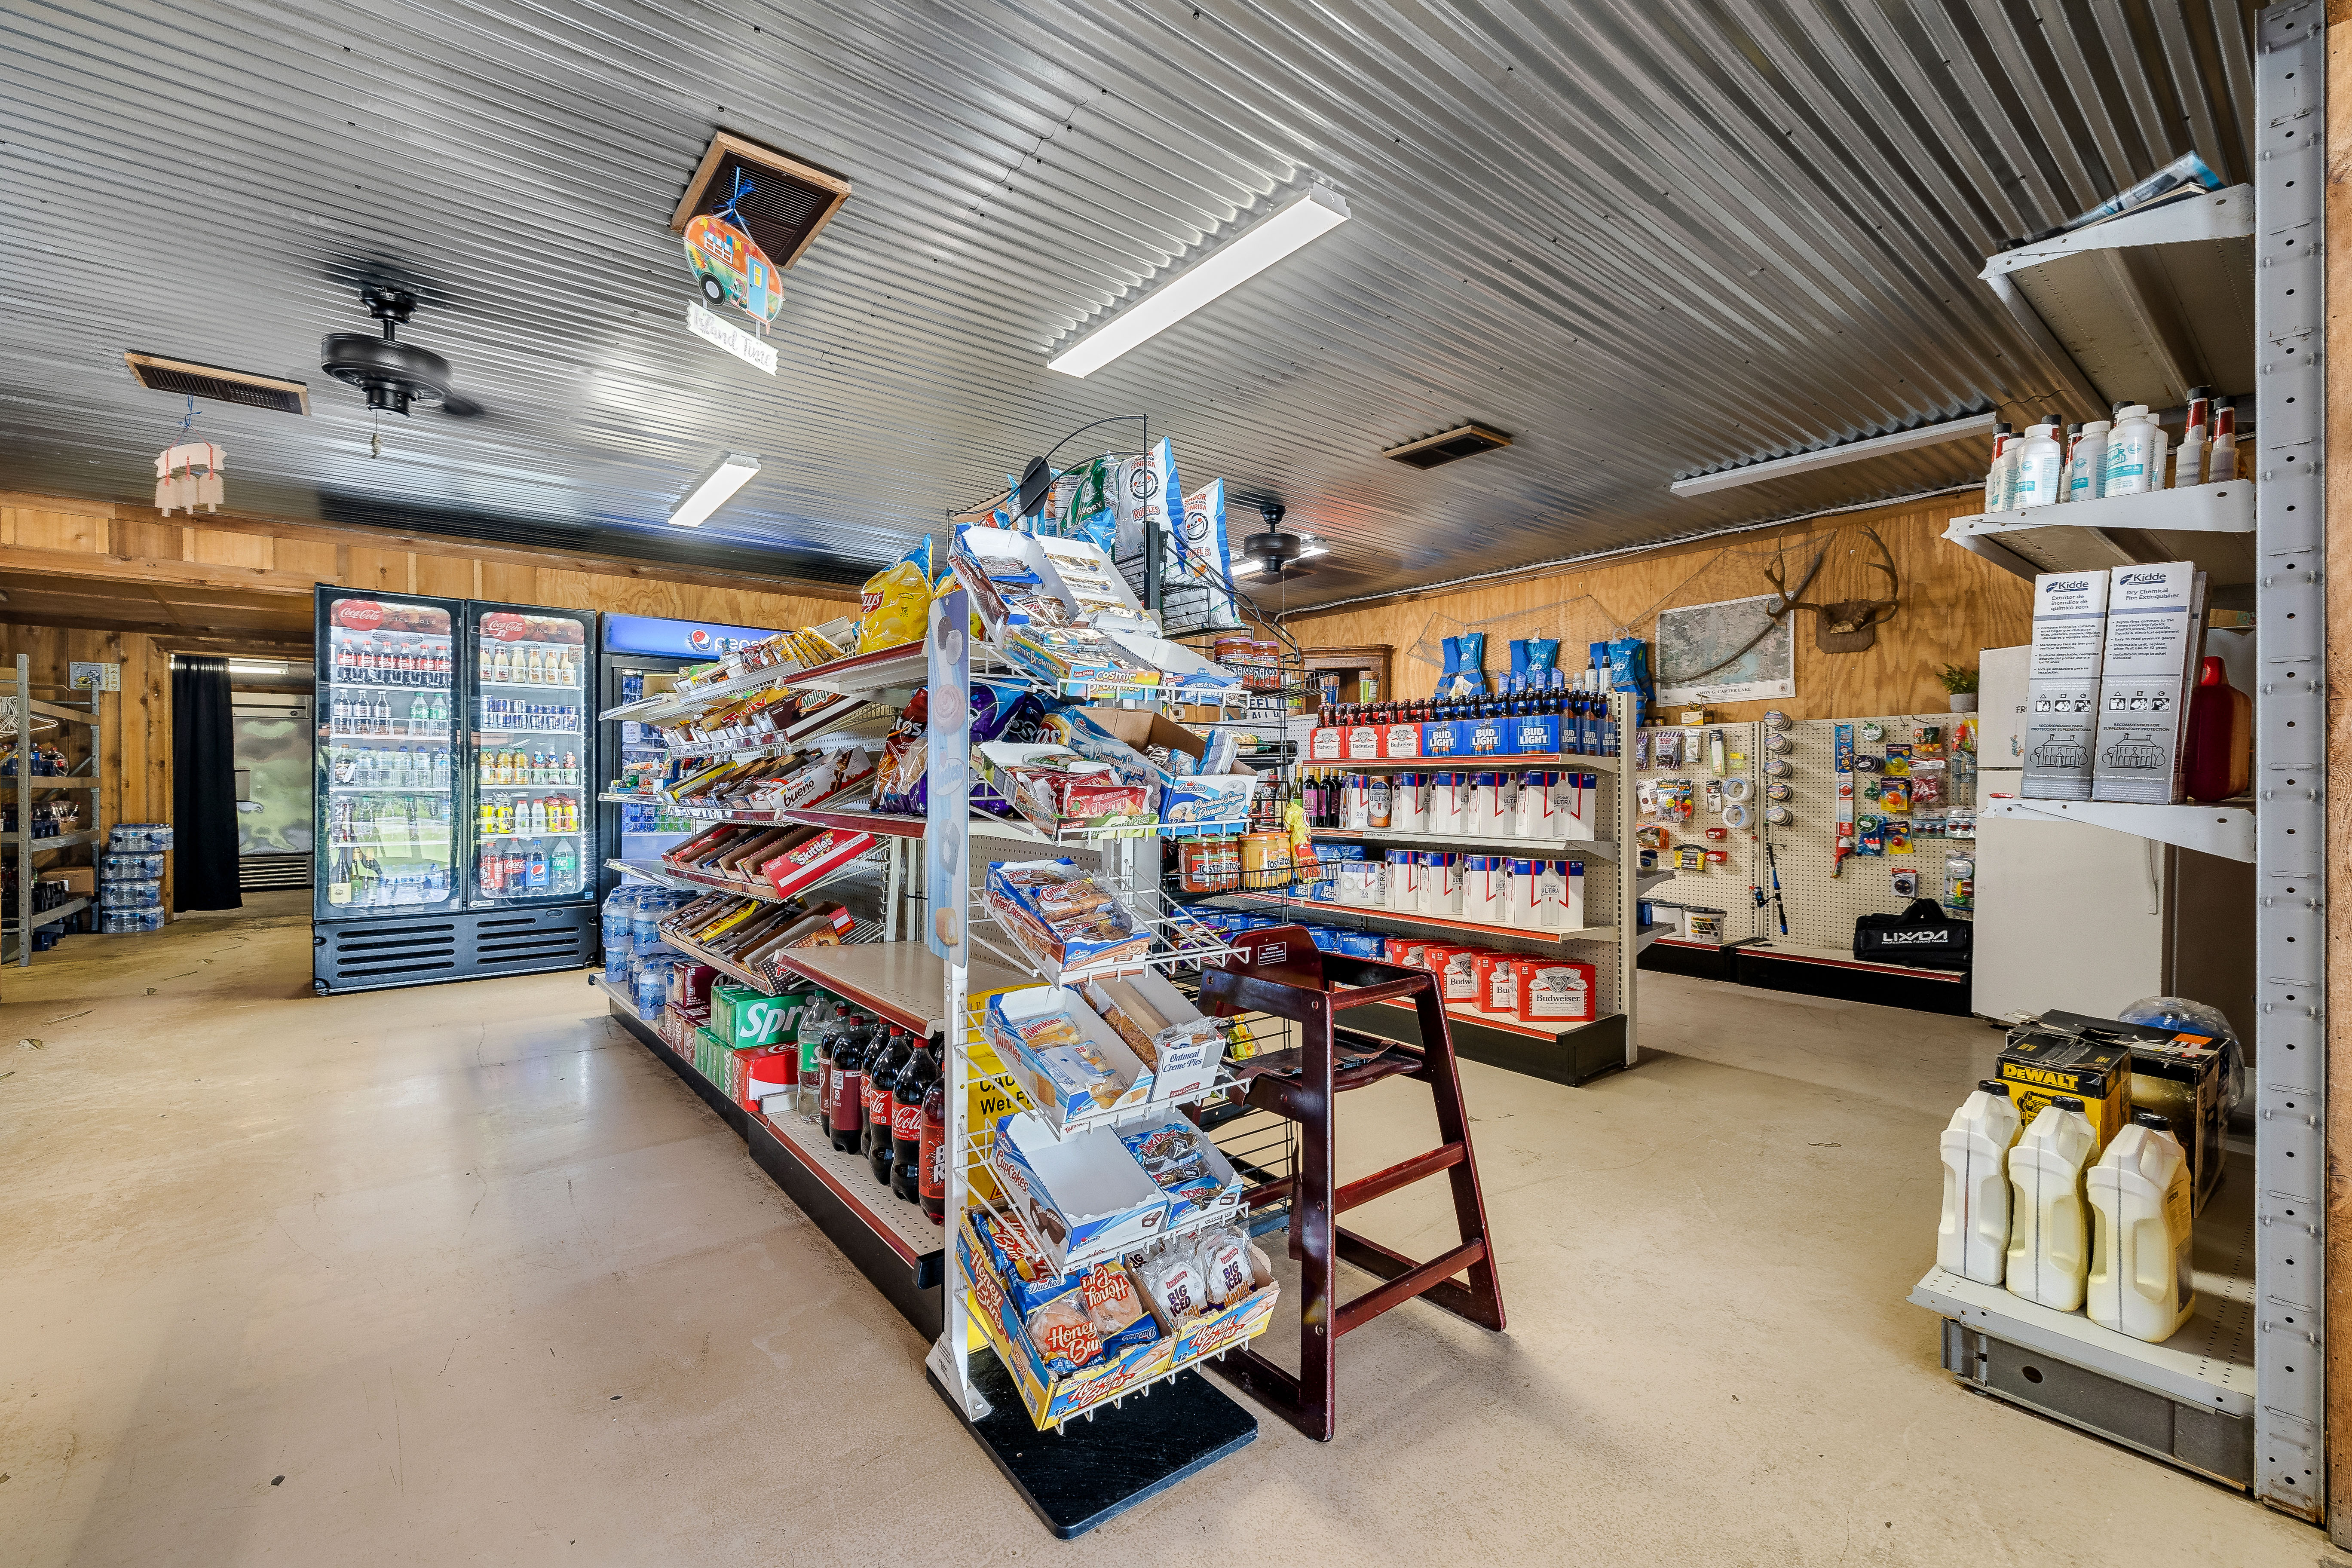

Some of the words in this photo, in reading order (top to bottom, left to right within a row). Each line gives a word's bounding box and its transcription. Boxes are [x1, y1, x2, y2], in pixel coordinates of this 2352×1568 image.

[1185, 493, 1207, 504] SABOR
[950, 554, 973, 580] Zingers
[2134, 573, 2166, 581] Kidde
[340, 607, 382, 620] Coca-Cola
[489, 620, 525, 632] Coca-Cola
[1012, 643, 1030, 659] Cosmic
[1030, 652, 1060, 676] Brownies
[1096, 671, 1136, 682] Cosmic
[722, 698, 767, 723] Twix
[1075, 717, 1091, 736] Duchess
[1476, 729, 1495, 737] BUD
[1524, 726, 1544, 736] BUD
[1429, 738, 1454, 747] LIGHT
[1433, 731, 1451, 739] BUD
[1472, 736, 1498, 745] LIGHT
[1519, 735, 1547, 744] LIGHT
[1562, 736, 1577, 744] LIGHT
[1583, 737, 1598, 745] LIGHT
[1094, 747, 1123, 772] Powdered
[1123, 756, 1144, 776] Sugar
[784, 780, 815, 807] bueno
[787, 780, 803, 792] Kinder
[1177, 783, 1207, 793] Duchess
[1089, 798, 1127, 815] Cherry
[1194, 796, 1224, 811] Powdered
[1224, 794, 1243, 805] Sugar
[1017, 800, 1030, 813] Apple
[1030, 807, 1042, 819] Fruit
[1043, 812, 1054, 824] Pies
[1197, 806, 1225, 820] Donuts
[1132, 816, 1150, 824] Pies
[797, 837, 834, 865] Skittles
[1041, 883, 1063, 902] Coffee
[1063, 880, 1082, 890] Cakes
[990, 891, 1007, 910] Coffee
[1006, 900, 1024, 922] Cakes
[1077, 921, 1097, 929] Cakes
[1883, 930, 1948, 942] LIXADA
[1065, 959, 1080, 972] Coffee
[1537, 994, 1580, 1003] Budweiser
[1020, 1017, 1063, 1038] Twinkies
[993, 1028, 1021, 1065] Twinkies
[1170, 1049, 1200, 1063] Oatmeal
[1163, 1063, 1185, 1073] Creme
[1186, 1059, 1202, 1069] Pies
[1170, 1087, 1183, 1097] Little
[1183, 1084, 1199, 1093] Debbie
[980, 1096, 1011, 1115] Wet
[1138, 1137, 1157, 1155] DING
[1153, 1129, 1178, 1143] DONGS
[996, 1150, 1029, 1193] CupCakes
[1179, 1187, 1208, 1198] DONGS
[1177, 1207, 1195, 1219] Hostess
[962, 1222, 974, 1249] Duchess
[1075, 1236, 1099, 1249] Hostess
[1229, 1248, 1238, 1260] Debbie
[971, 1251, 1002, 1305] Honey
[1223, 1261, 1239, 1280] BIG
[1167, 1278, 1176, 1289] Little
[1175, 1271, 1187, 1284] Debbie
[1225, 1272, 1243, 1292] ICED
[1087, 1279, 1127, 1308] Honey
[1167, 1285, 1187, 1305] BIG
[1224, 1281, 1252, 1308] Honey
[977, 1280, 1002, 1330] Buns
[1169, 1296, 1191, 1317] ICED
[1048, 1322, 1096, 1348] Honey
[1184, 1323, 1207, 1336] Duchess
[1190, 1317, 1236, 1348] Honey
[1197, 1326, 1241, 1355] Buns
[1177, 1352, 1188, 1363] 12
[1062, 1378, 1090, 1392] Duchess
[1069, 1366, 1121, 1400] Honey
[1079, 1375, 1131, 1408] Buns
[1055, 1405, 1067, 1416] 12
